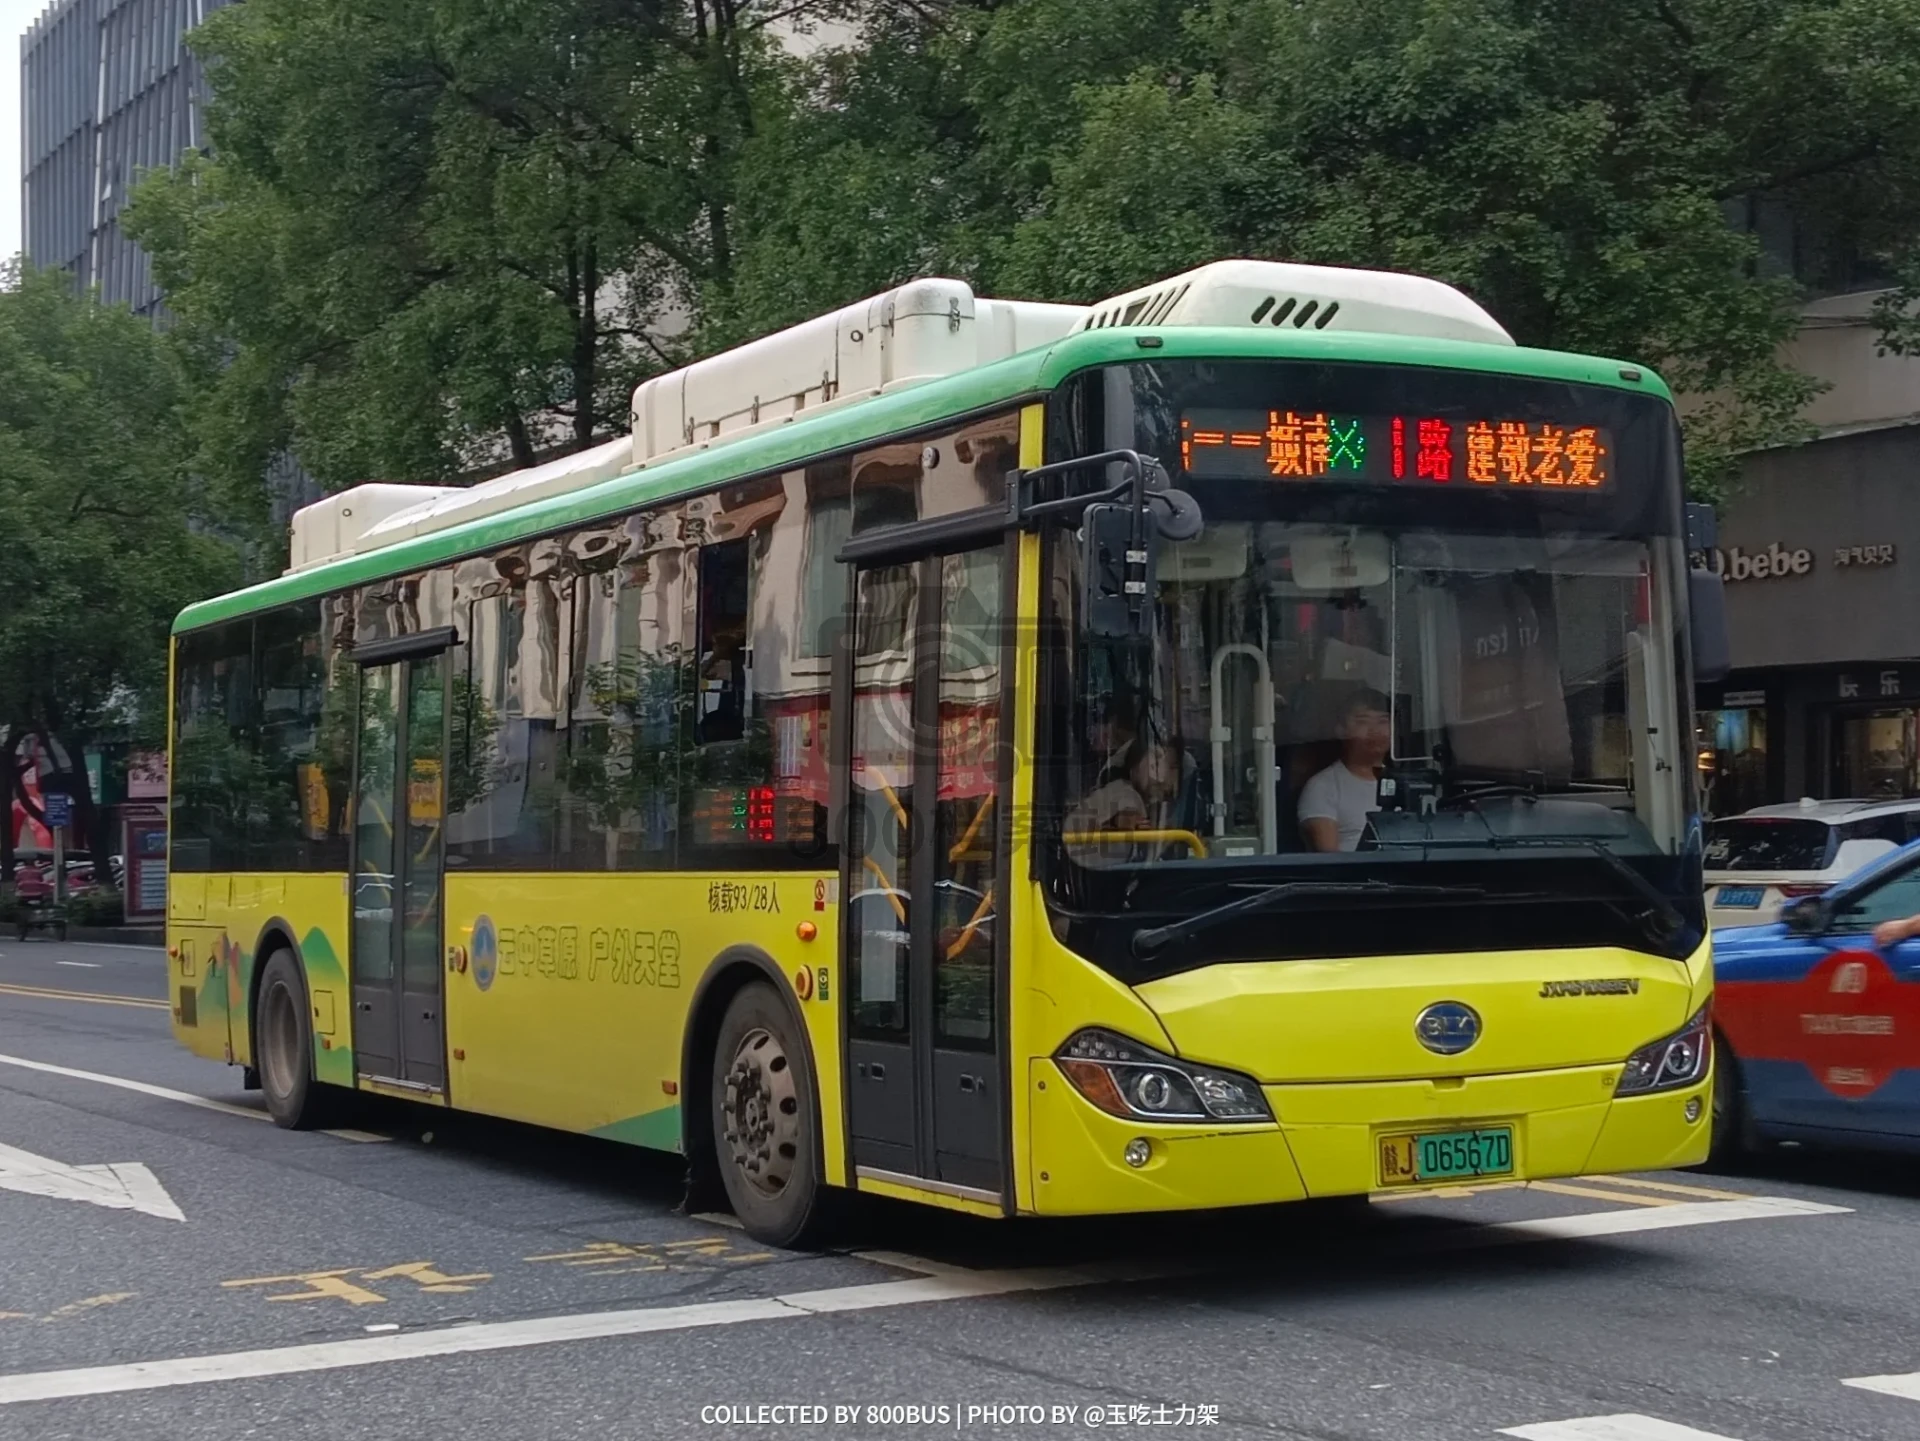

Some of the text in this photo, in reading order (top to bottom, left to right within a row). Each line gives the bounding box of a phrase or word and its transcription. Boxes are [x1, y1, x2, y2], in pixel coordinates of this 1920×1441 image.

[708, 881, 781, 914] 核载93/28人
[499, 924, 579, 981] 云中草原
[588, 926, 681, 989] 户外天堂
